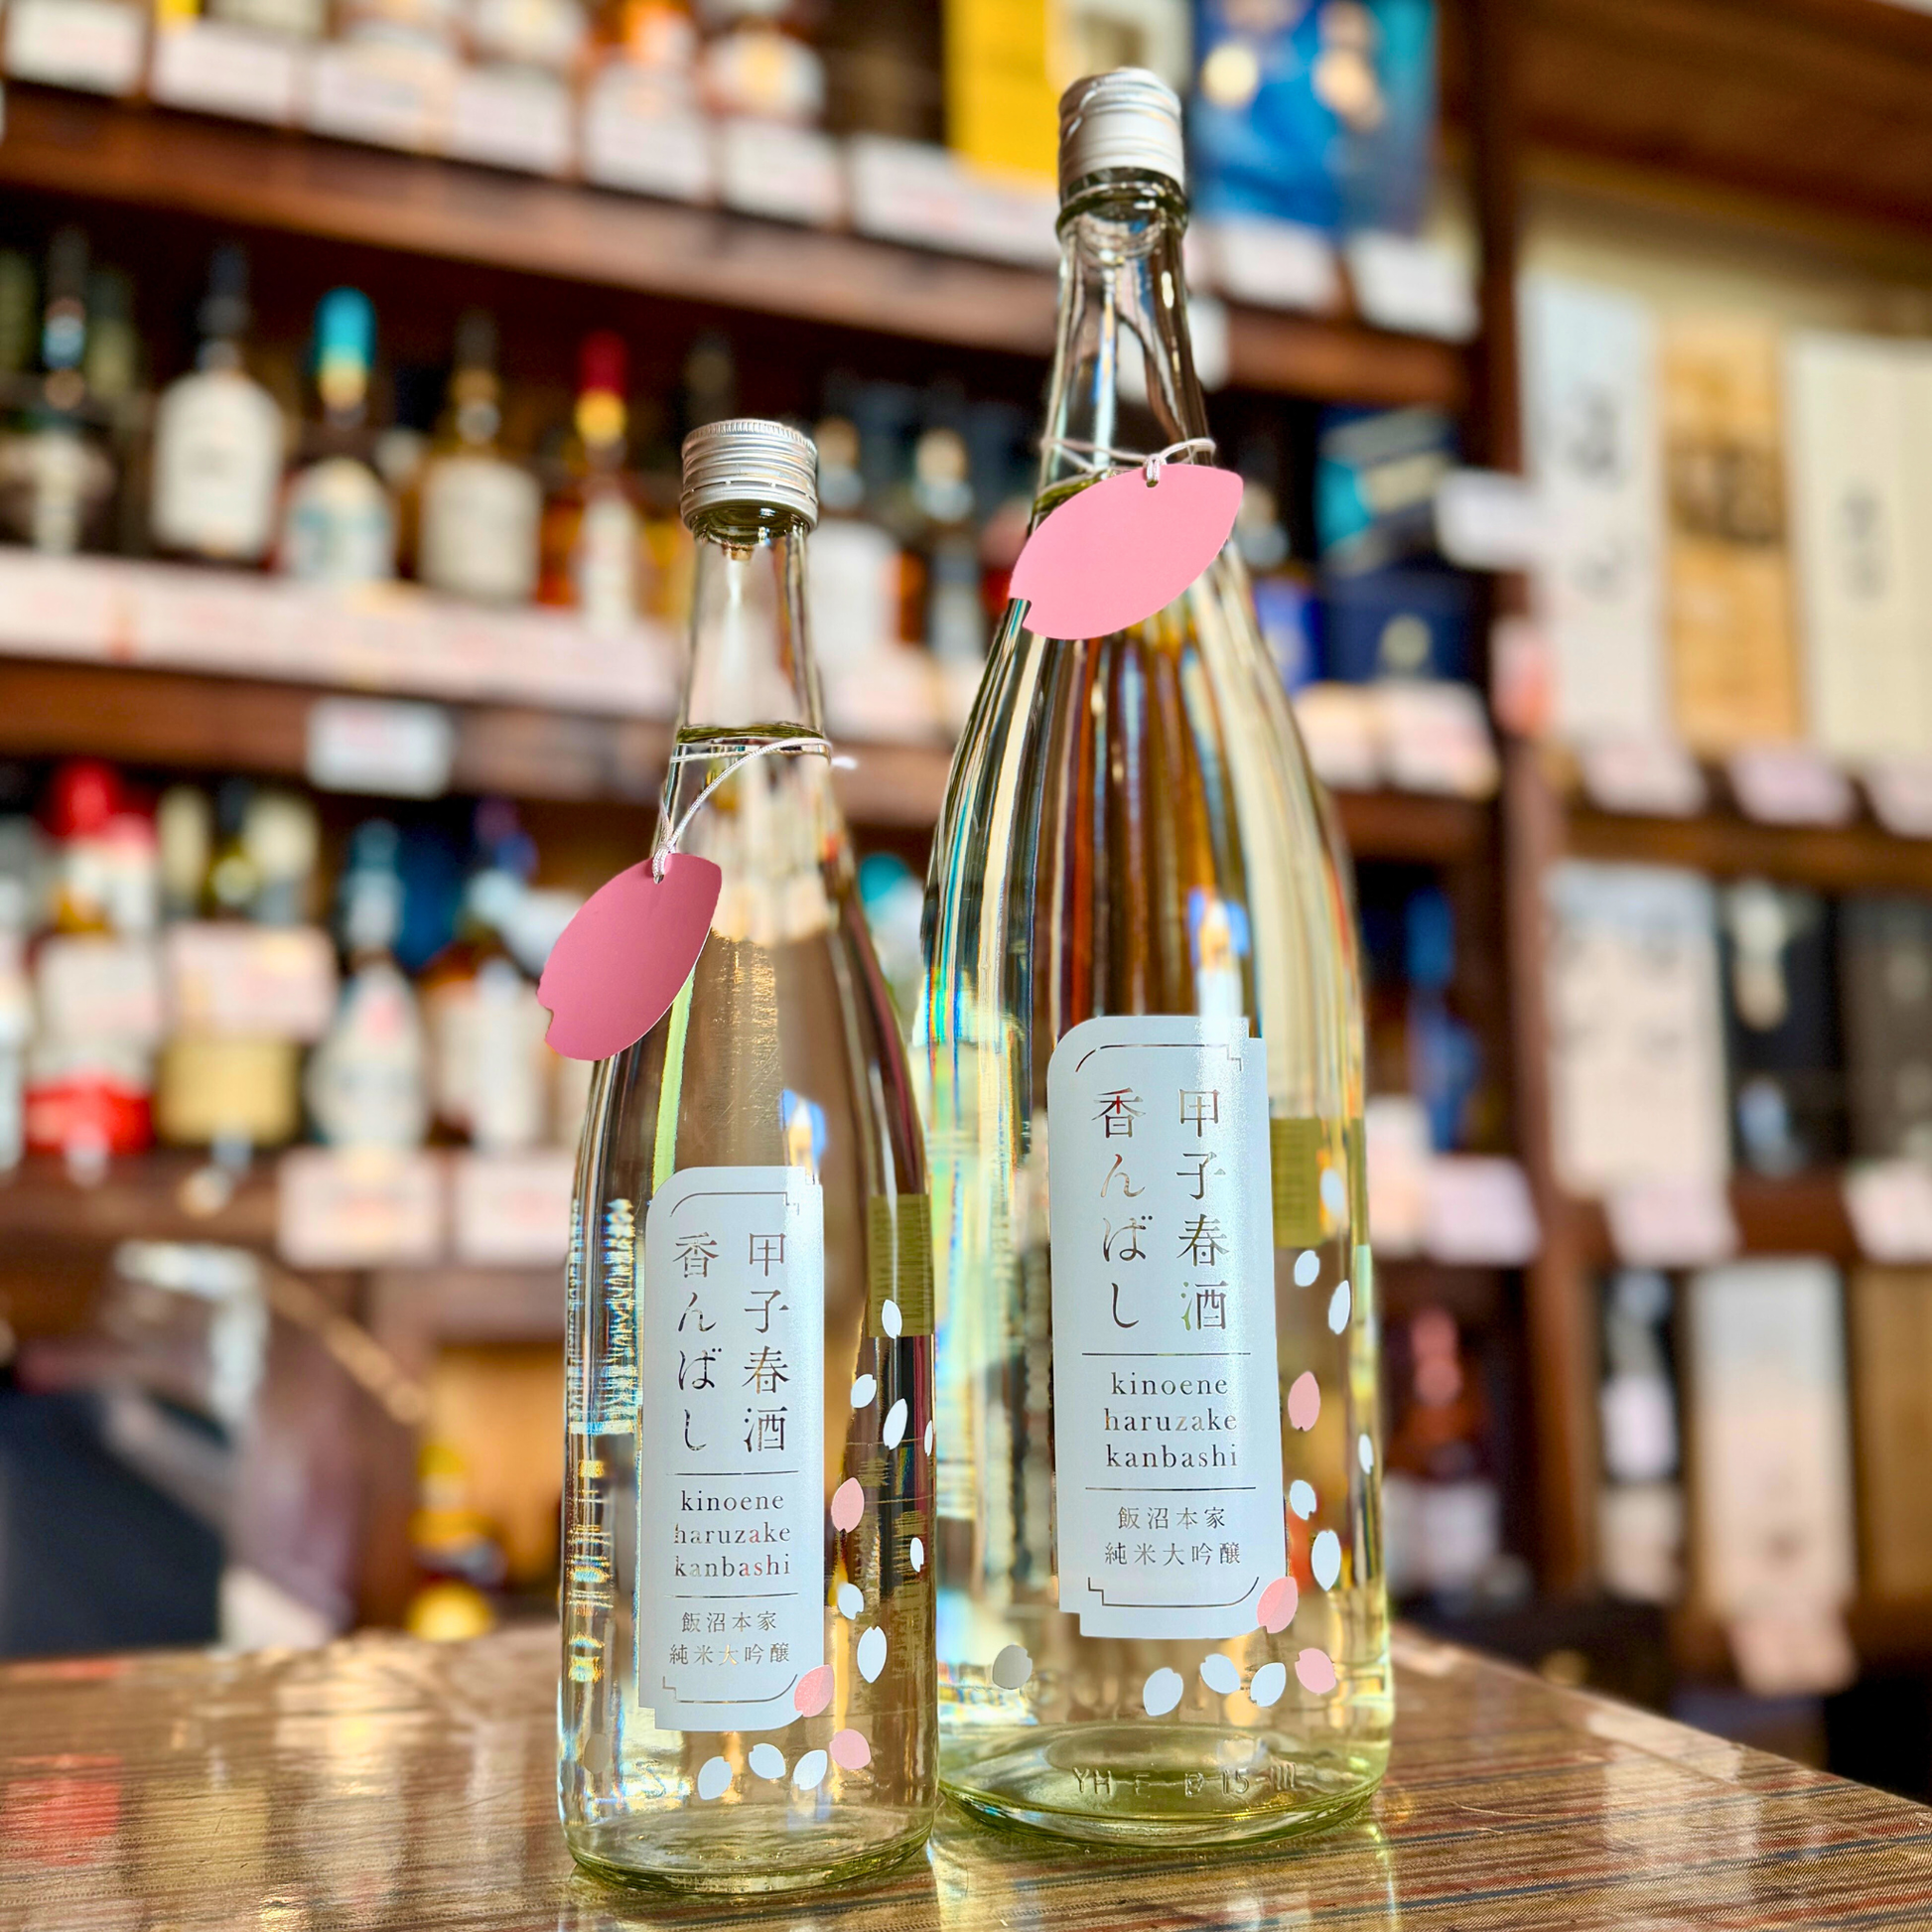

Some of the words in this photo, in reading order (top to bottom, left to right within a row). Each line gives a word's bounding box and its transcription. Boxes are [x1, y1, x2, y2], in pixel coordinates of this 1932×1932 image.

[1091, 1086, 1154, 1329] 香んばし
[1174, 1088, 1230, 1332] 甲子春酒
[672, 1231, 723, 1451] 香んばし
[742, 1232, 791, 1452] 甲子春酒
[1110, 1371, 1229, 1396] kinoene
[1103, 1407, 1238, 1433] haruzake
[1105, 1443, 1239, 1468] kanbashi
[680, 1489, 784, 1512] kinoene
[1117, 1505, 1226, 1531] 飯沼本家
[673, 1521, 791, 1545] haruzake
[674, 1553, 791, 1578] kanbashi
[1104, 1541, 1241, 1567] 純米大吟醸
[681, 1609, 777, 1634] 飯沼本家
[669, 1641, 790, 1667] 純米大吟醸
